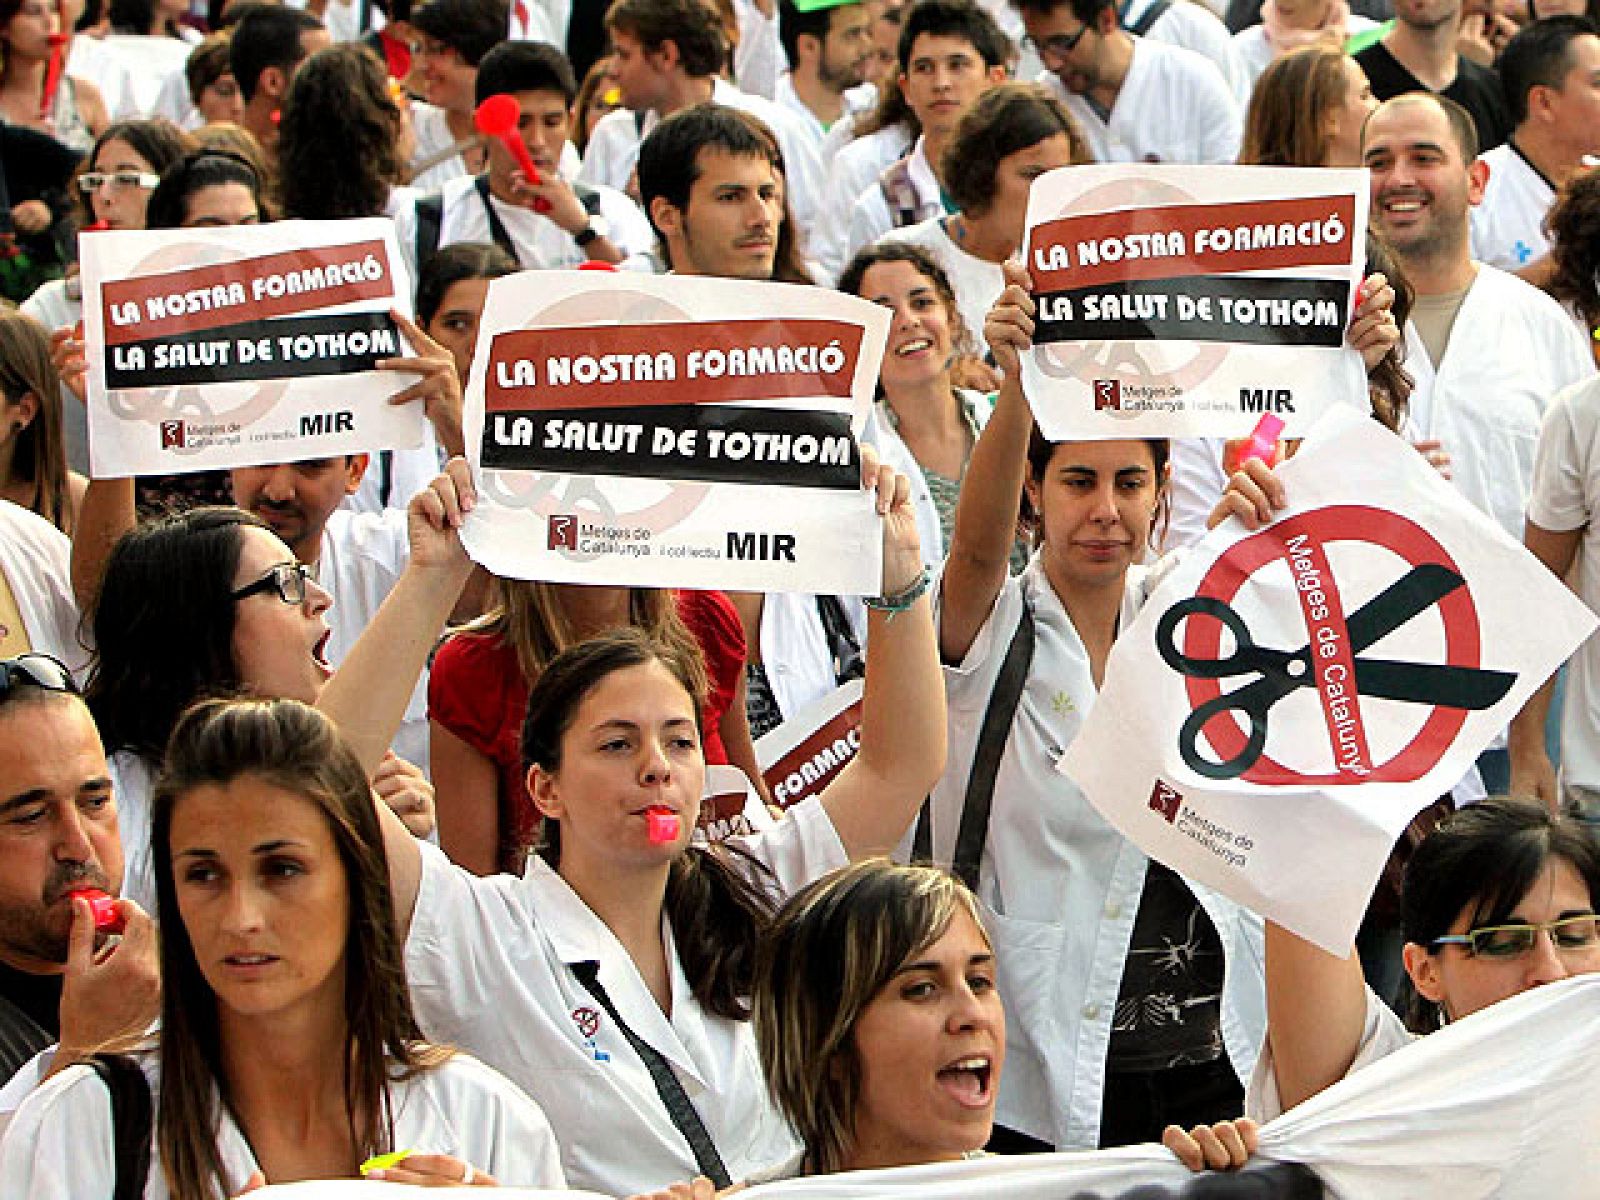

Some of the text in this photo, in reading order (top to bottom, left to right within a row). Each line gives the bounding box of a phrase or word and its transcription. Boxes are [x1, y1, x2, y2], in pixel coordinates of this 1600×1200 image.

[1034, 213, 1345, 271] LA NOSTRA FORMACIÓ
[110, 254, 383, 326] LA NOSTRA FORMACIÓ
[1039, 294, 1339, 326] LA SALUT DE TOTHOM
[113, 328, 396, 370] LA SALUT DE TOTHOM
[496, 339, 846, 388] LA NOSTRA FORMACIÓ
[300, 409, 354, 438] MIR
[1240, 388, 1295, 413] MIR
[494, 414, 851, 466] LA SALUT DE TOTHOM
[726, 531, 796, 562] MIR
[1285, 534, 1329, 620] Metges
[1317, 626, 1341, 658] de
[1177, 818, 1248, 868] Catalunya
[1181, 806, 1254, 851] Metges de
